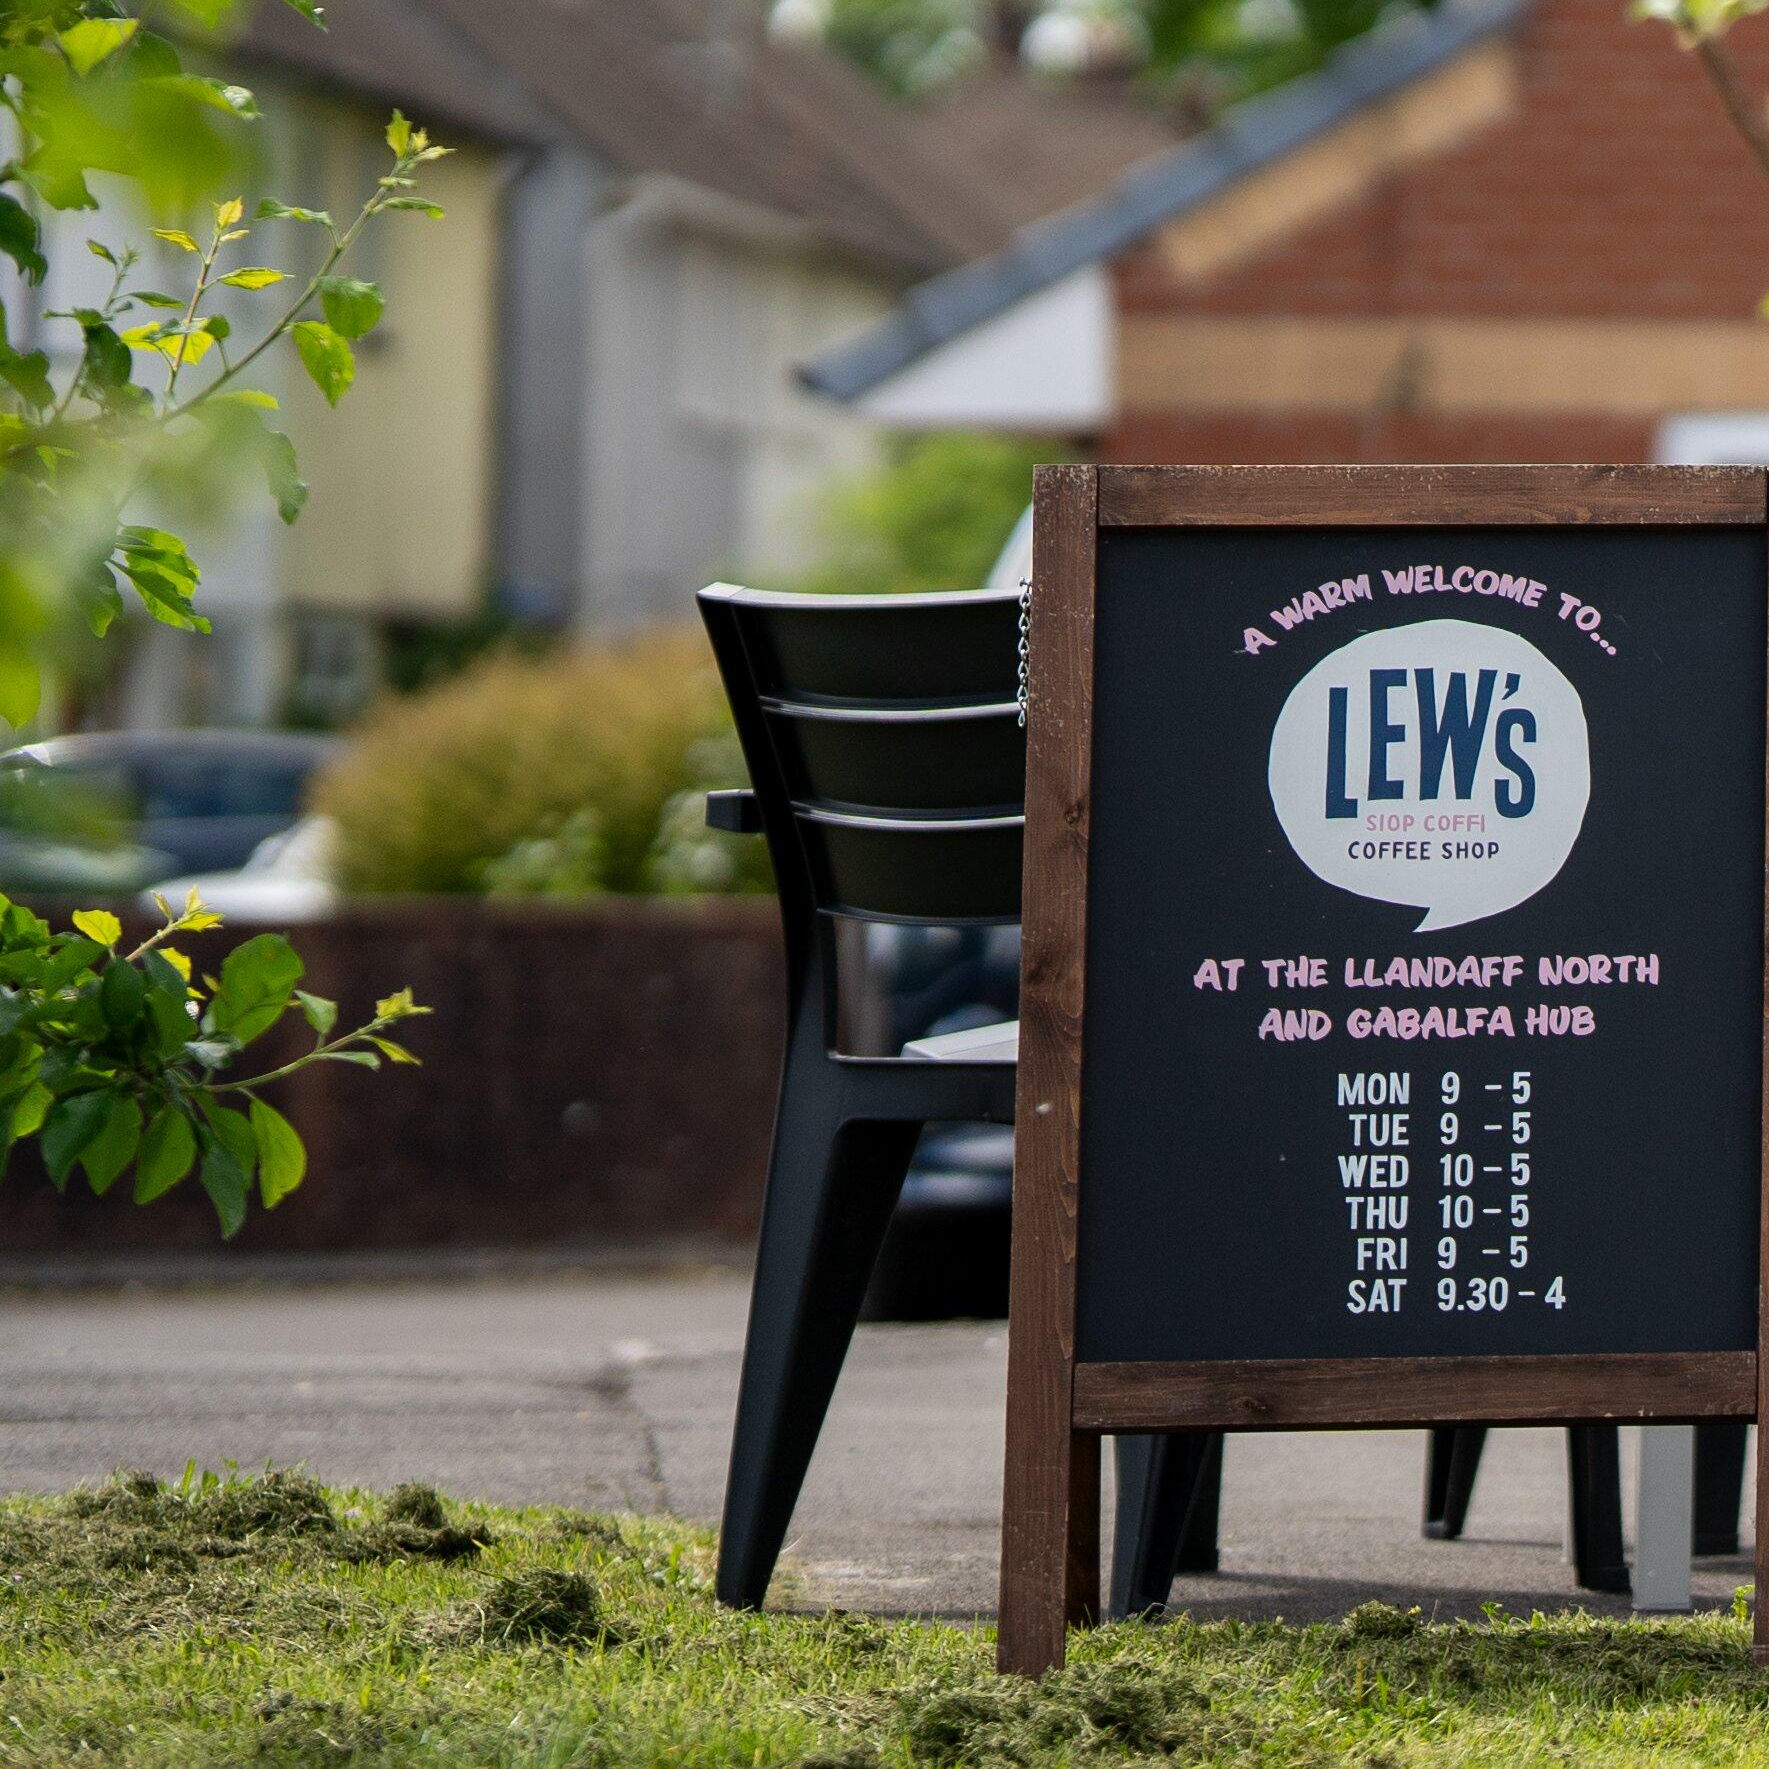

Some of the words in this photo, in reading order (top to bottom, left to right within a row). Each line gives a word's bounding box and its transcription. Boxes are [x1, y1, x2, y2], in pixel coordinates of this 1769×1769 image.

[1243, 627, 1278, 655] A
[1269, 573, 1374, 631] WARM
[1380, 564, 1548, 608] WELCOME
[1558, 592, 1617, 656] TO...
[1324, 666, 1538, 820] LEW'S
[1365, 813, 1415, 833] SIOP
[1423, 813, 1486, 834] COFFI
[1347, 840, 1432, 861] COFFEE
[1441, 841, 1500, 860] SHOP
[1193, 957, 1246, 992] AT
[1261, 955, 1329, 988] THE
[1344, 955, 1524, 988] LLANDAFF
[1538, 953, 1660, 986] NORTH
[1258, 1007, 1332, 1042] AND
[1346, 1005, 1516, 1040] GABALFA
[1524, 1003, 1596, 1037] HUB
[1337, 1071, 1410, 1106] MON
[1441, 1071, 1460, 1105] 9
[1511, 1071, 1531, 1105] 5
[1348, 1113, 1410, 1147] TUE
[1440, 1112, 1459, 1146] 9
[1512, 1111, 1531, 1145] 5
[1337, 1154, 1410, 1189] WED
[1439, 1153, 1474, 1187] 10
[1510, 1152, 1531, 1186] 5
[1345, 1195, 1409, 1230] THU
[1438, 1194, 1474, 1229] 10
[1510, 1194, 1530, 1228] 5
[1357, 1237, 1408, 1271] FRI
[1437, 1236, 1457, 1270] 9
[1509, 1235, 1528, 1269] 5
[1346, 1278, 1408, 1314] SAT
[1437, 1276, 1509, 1312] 9.30
[1544, 1275, 1567, 1310] 4
